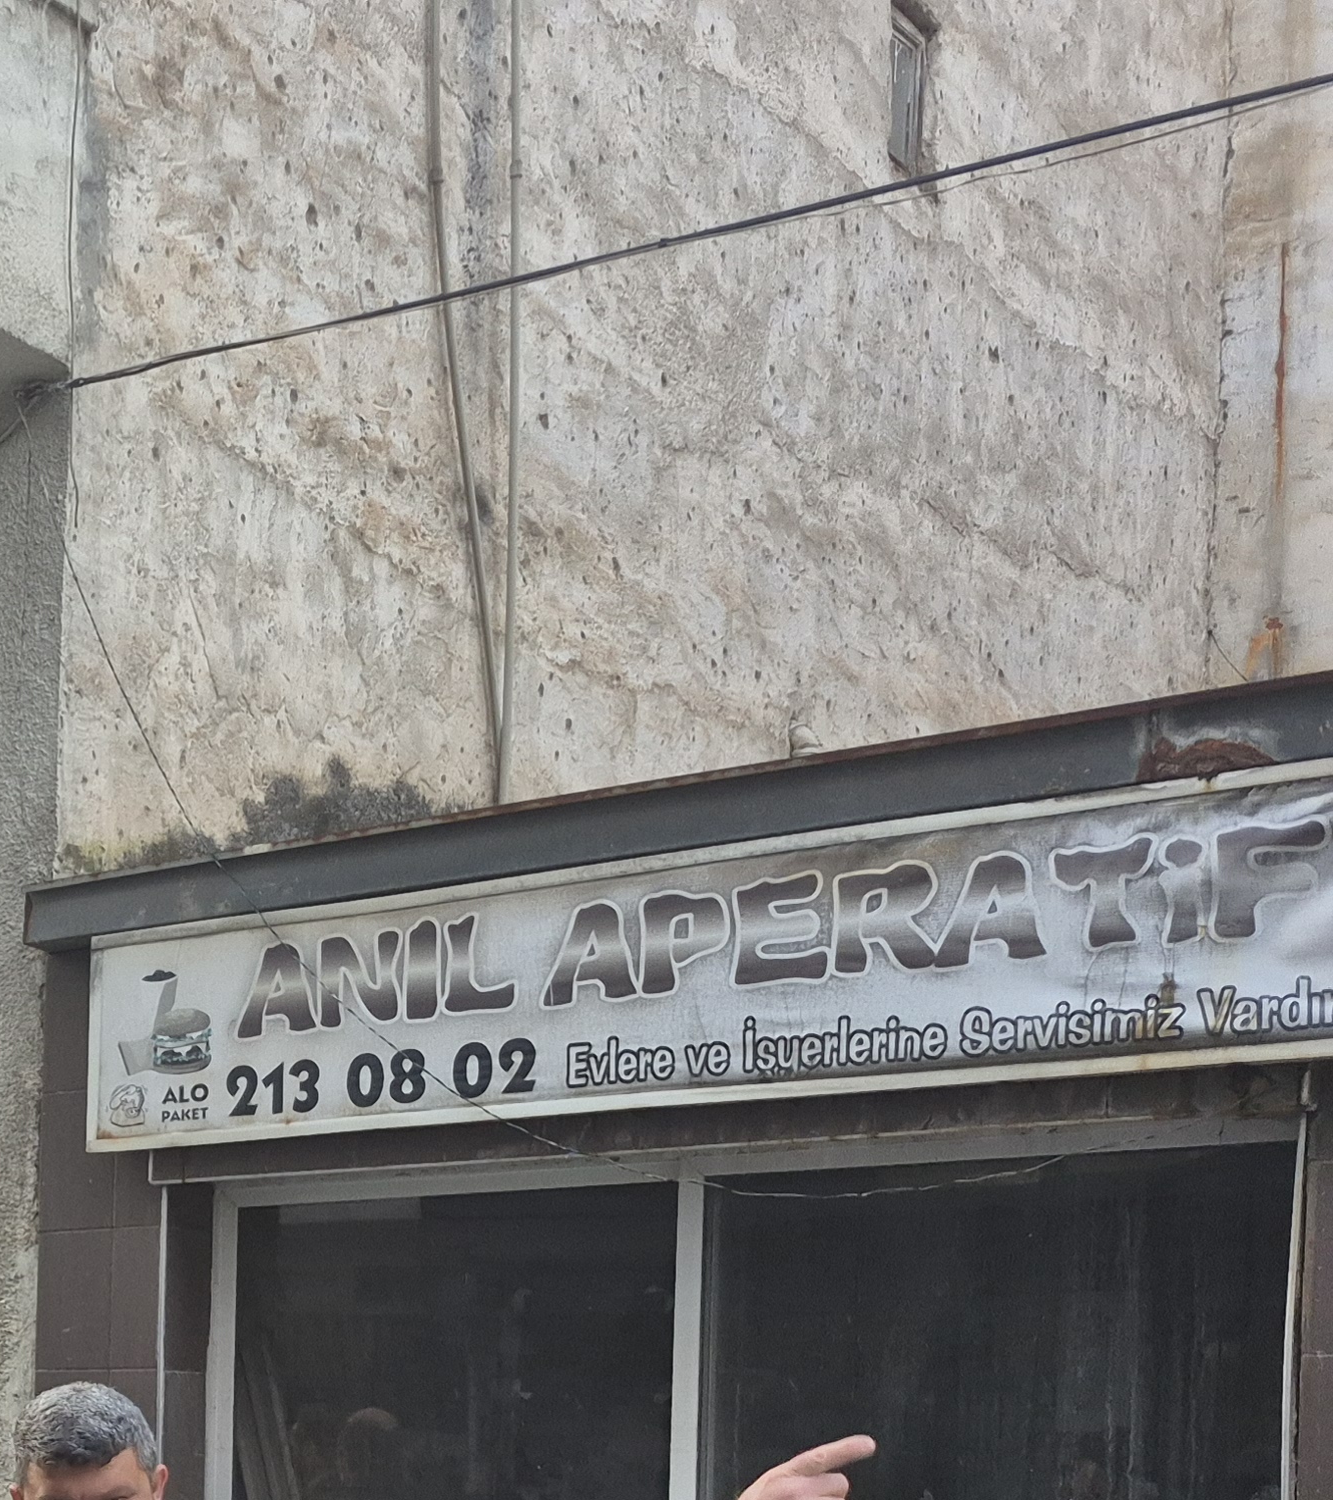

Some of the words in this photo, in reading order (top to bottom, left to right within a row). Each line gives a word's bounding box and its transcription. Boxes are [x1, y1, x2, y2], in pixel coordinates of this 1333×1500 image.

[236, 911, 517, 1041] ANIL
[226, 1059, 321, 1117] 213
[346, 1048, 426, 1108] 08
[453, 1037, 537, 1099] 02
[566, 1036, 676, 1089] Evlere
[684, 1039, 731, 1076] ve
[959, 994, 1186, 1058] Servisimiz
[161, 1083, 209, 1105] ALO
[161, 1107, 209, 1123] PAKET
